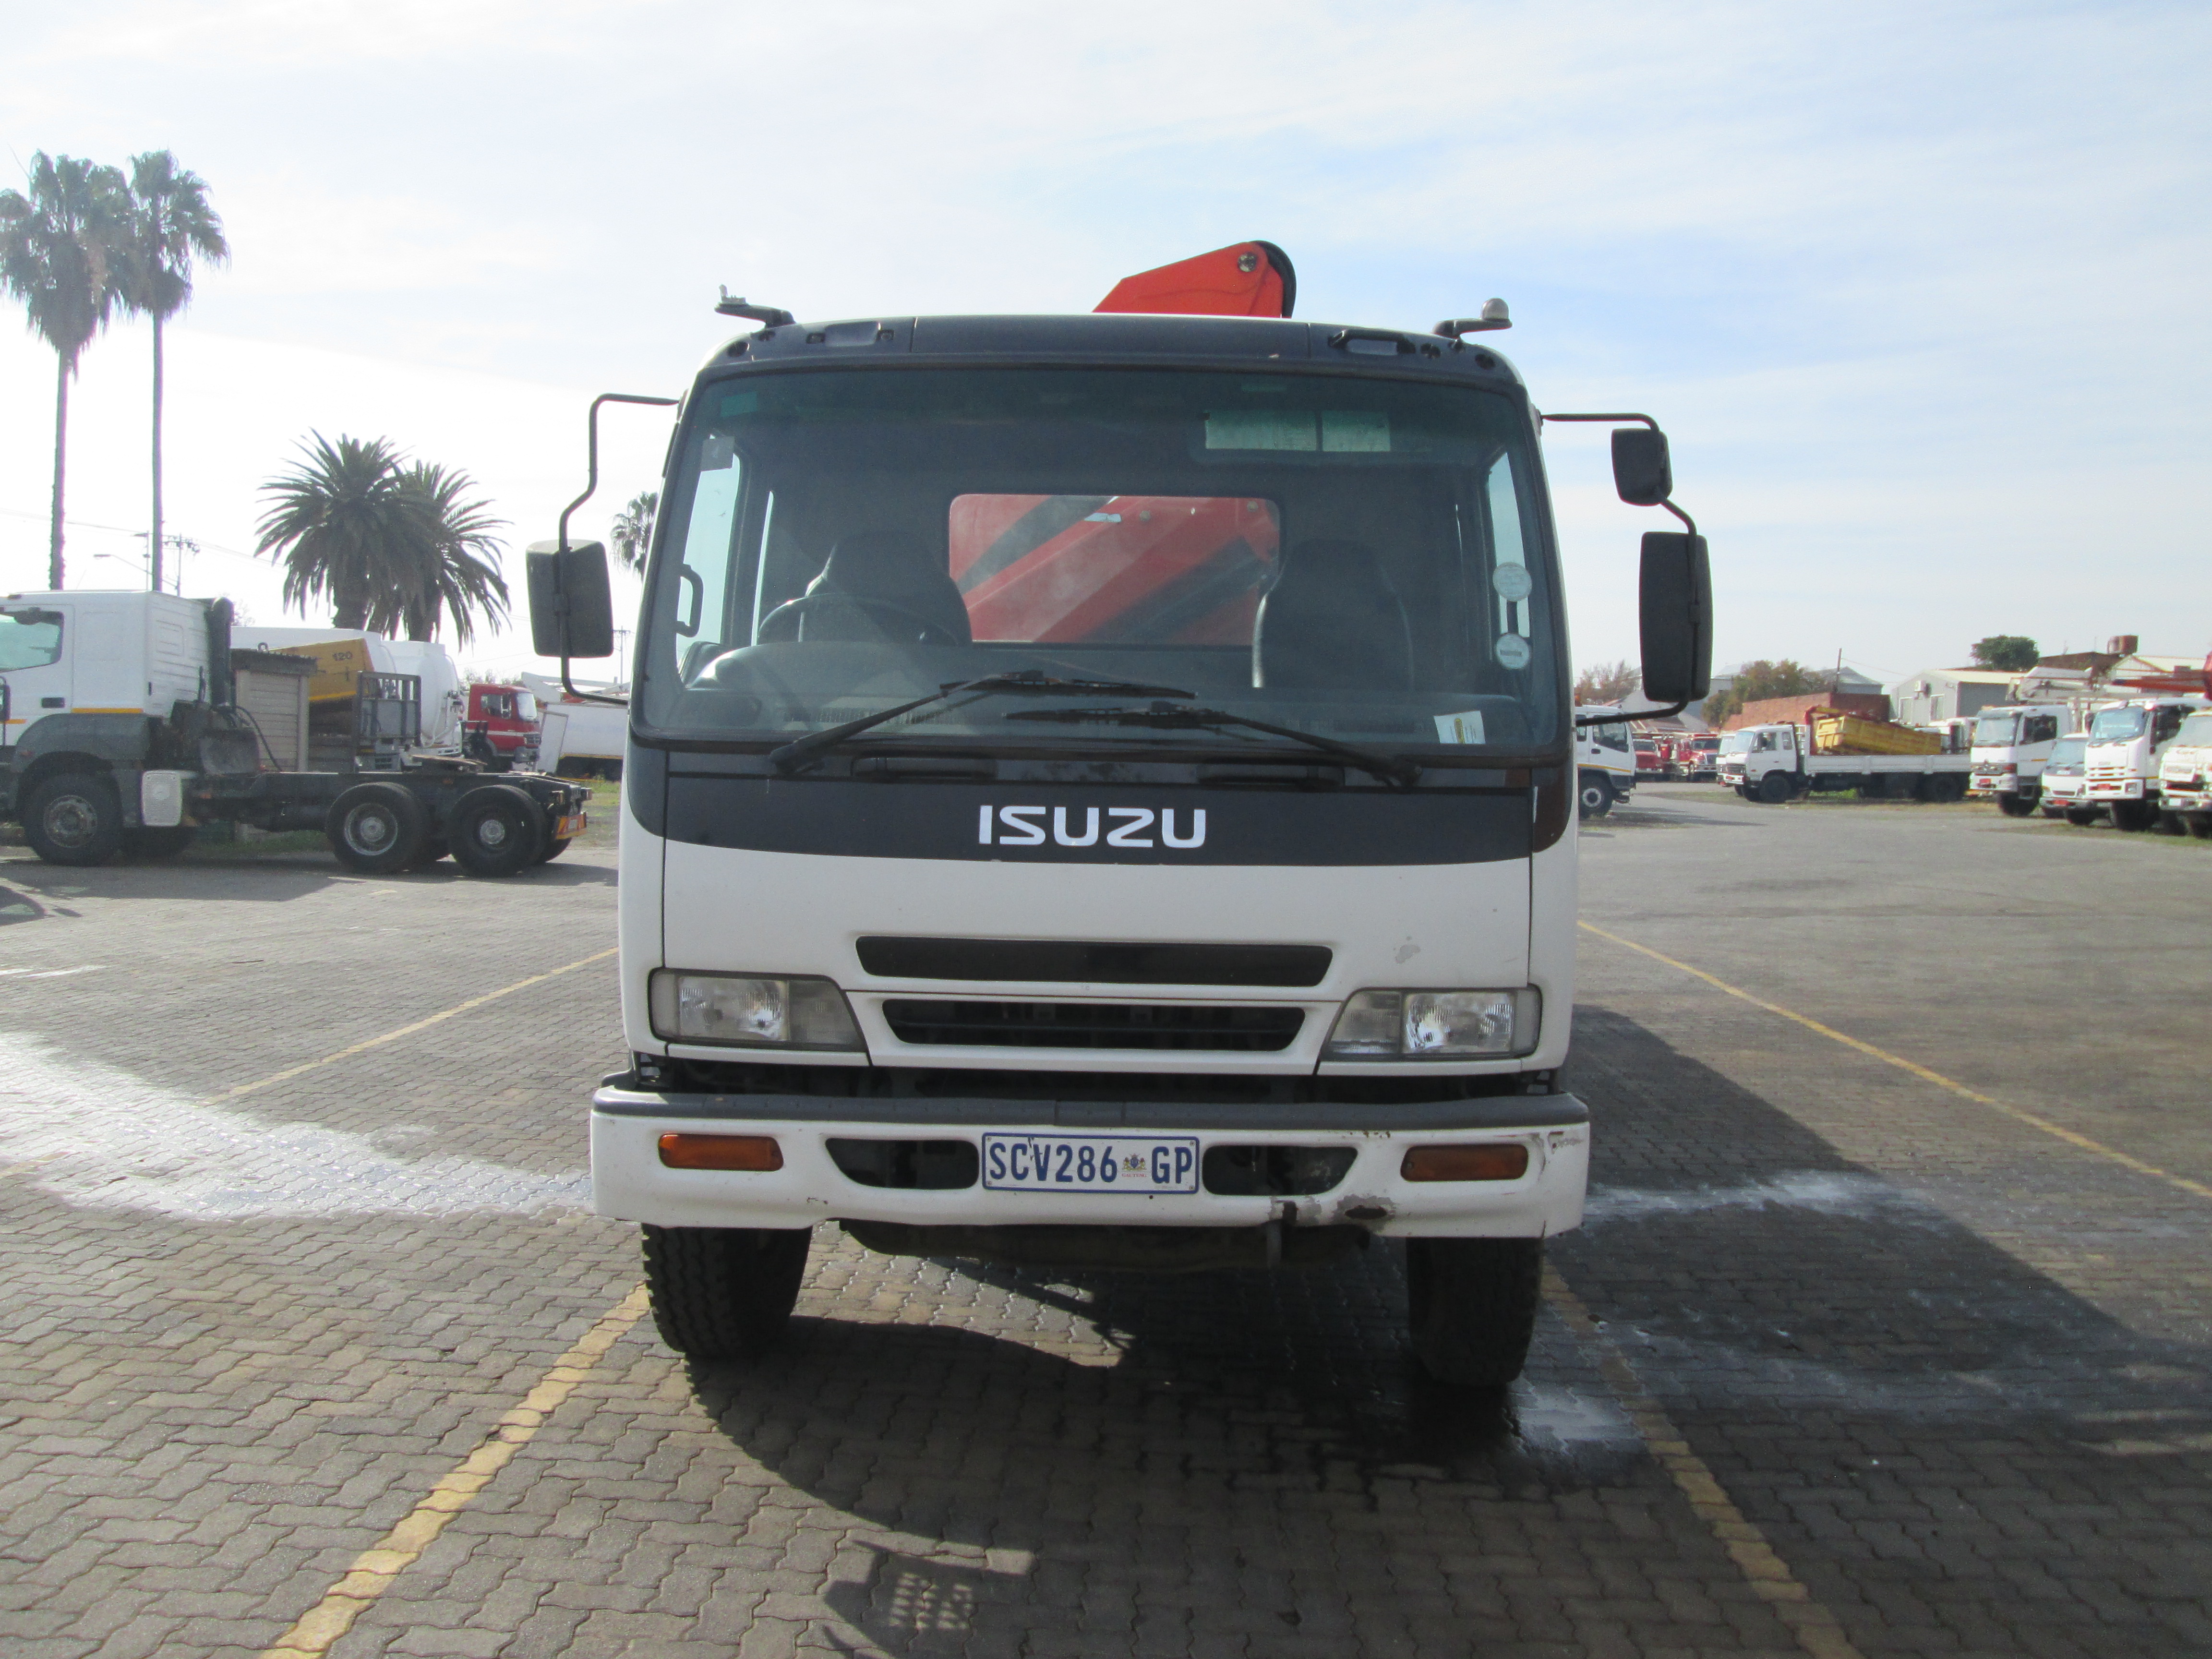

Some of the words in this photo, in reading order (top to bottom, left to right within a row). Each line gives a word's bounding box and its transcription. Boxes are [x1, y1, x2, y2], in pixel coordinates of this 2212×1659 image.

[978, 805, 1206, 849] ISUZU
[989, 1142, 1118, 1183] SCV286
[1152, 1146, 1192, 1184] GP
